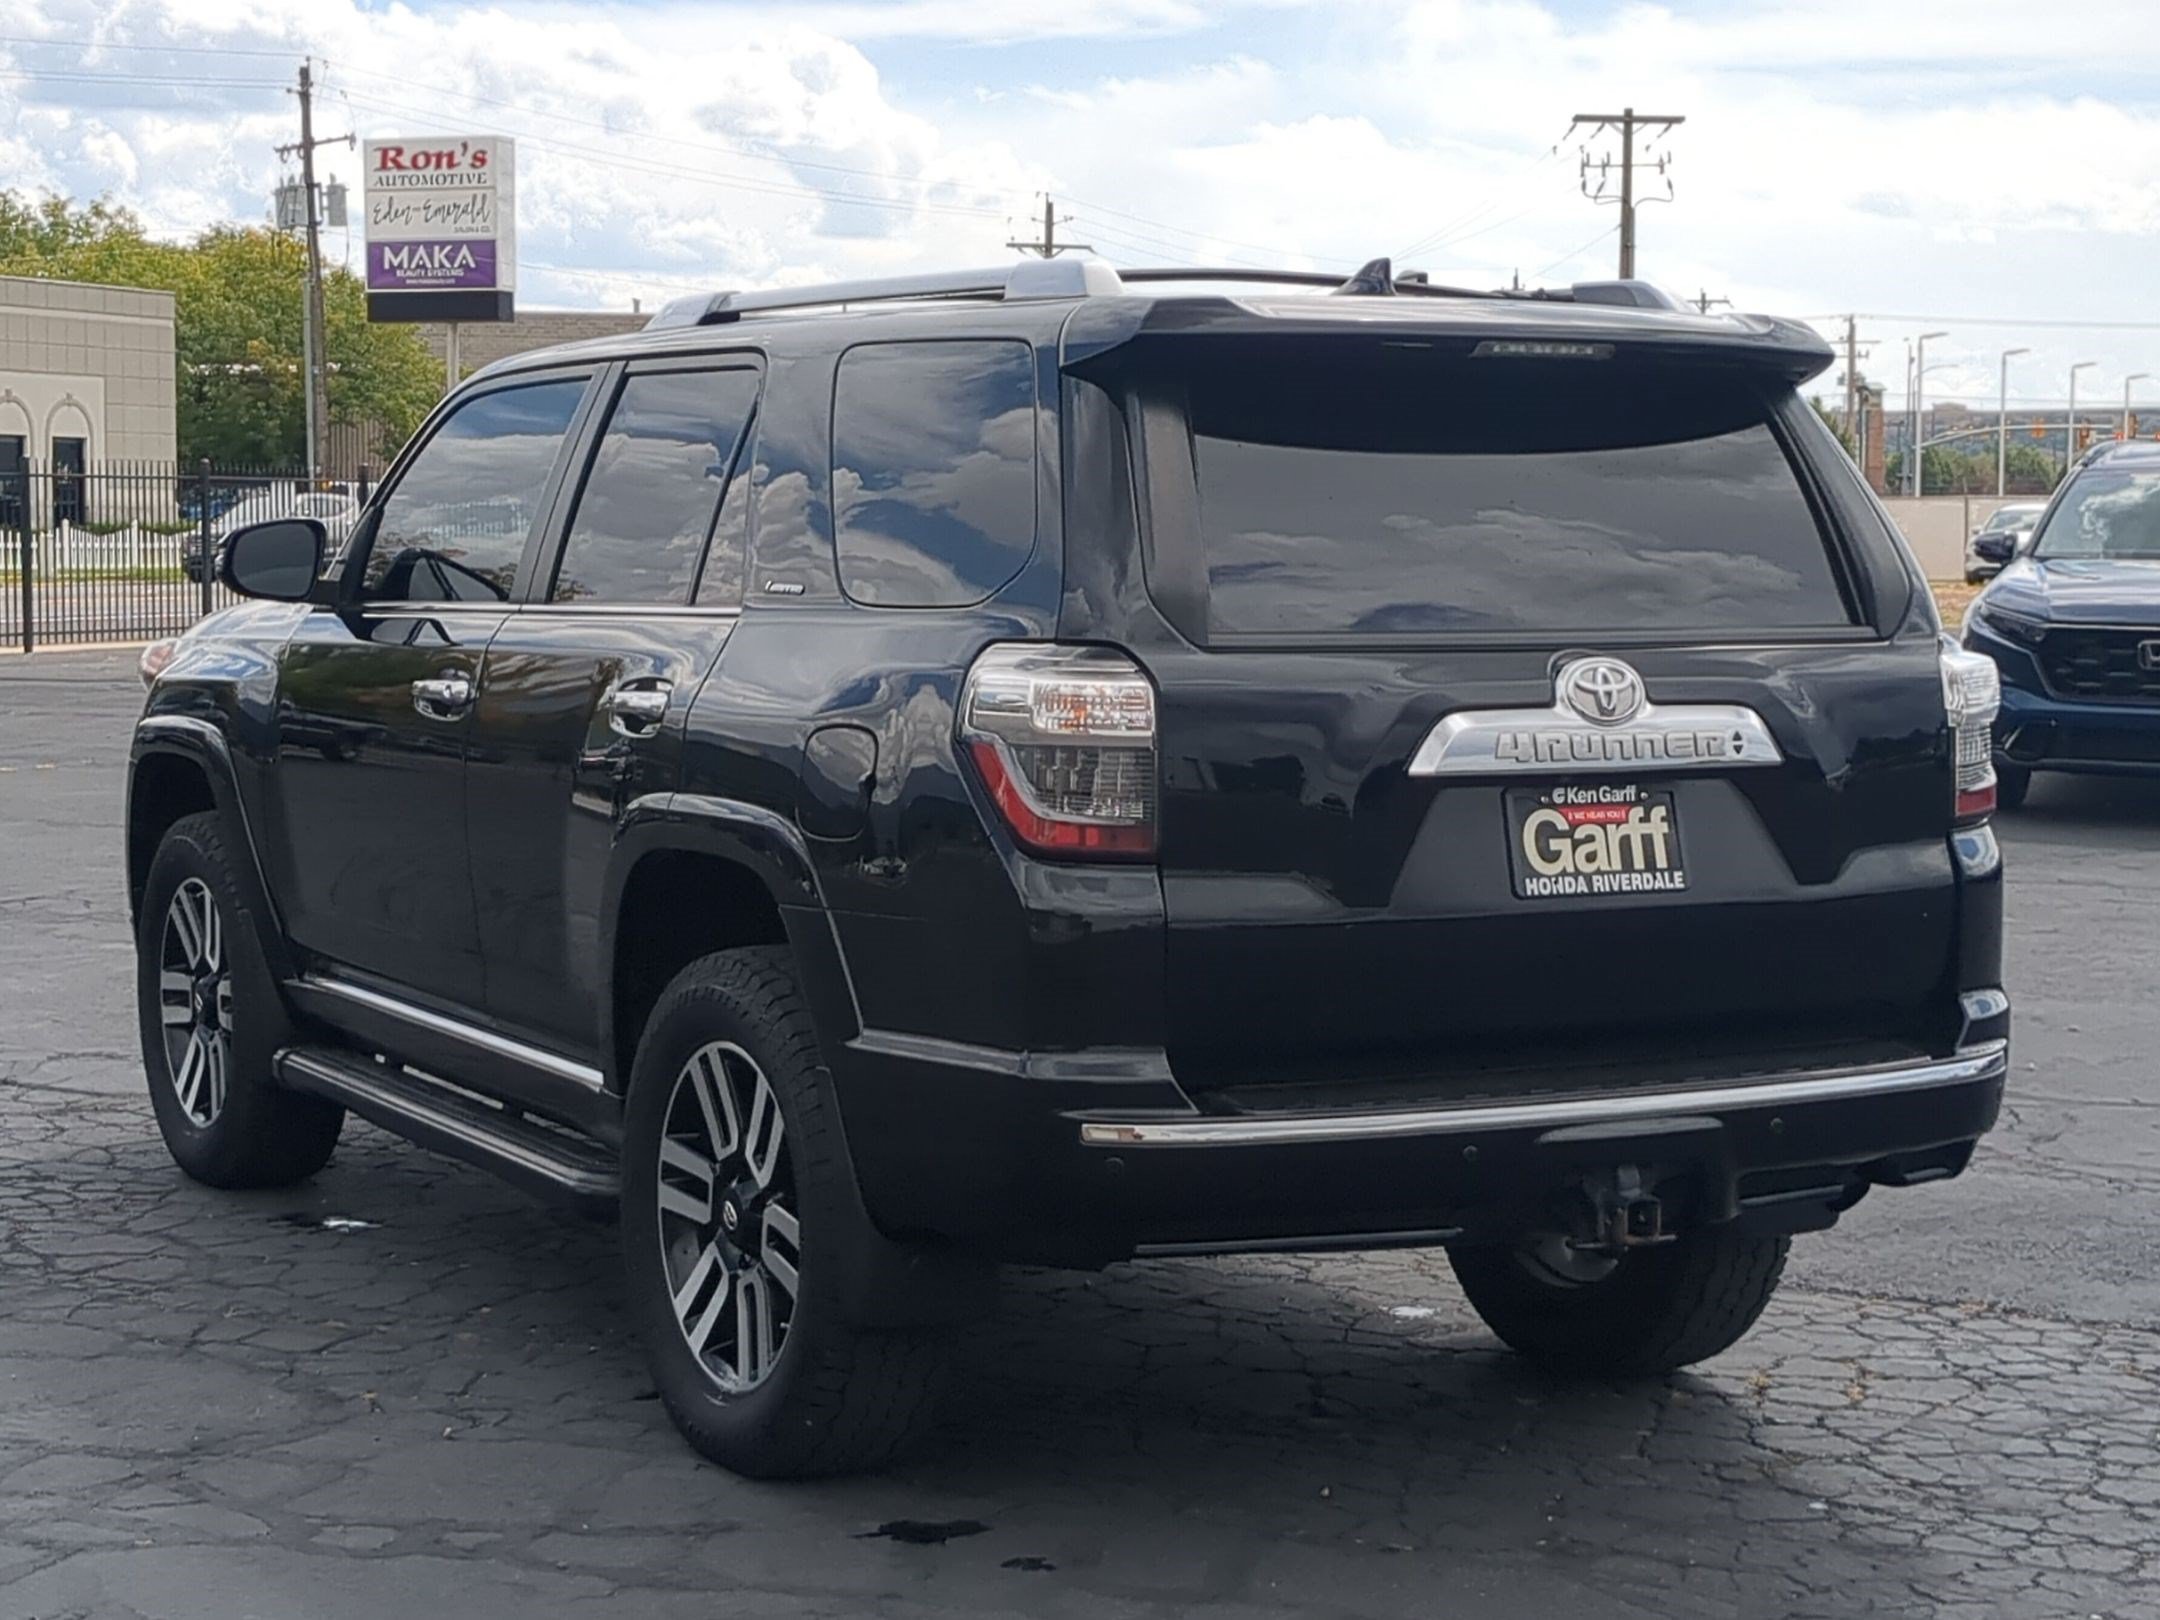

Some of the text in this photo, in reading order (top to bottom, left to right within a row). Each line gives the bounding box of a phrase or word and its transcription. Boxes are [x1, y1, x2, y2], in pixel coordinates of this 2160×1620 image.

[373, 140, 488, 172] Ron's
[374, 172, 487, 187] AUTOMOTIVE
[384, 244, 476, 269] MAKA
[396, 268, 464, 277] BEAUTY SYSTEMS
[1567, 785, 1637, 804] Ken Garff
[1523, 806, 1669, 875] Garff
[1525, 871, 1686, 897] HONDA RIVERDALE
